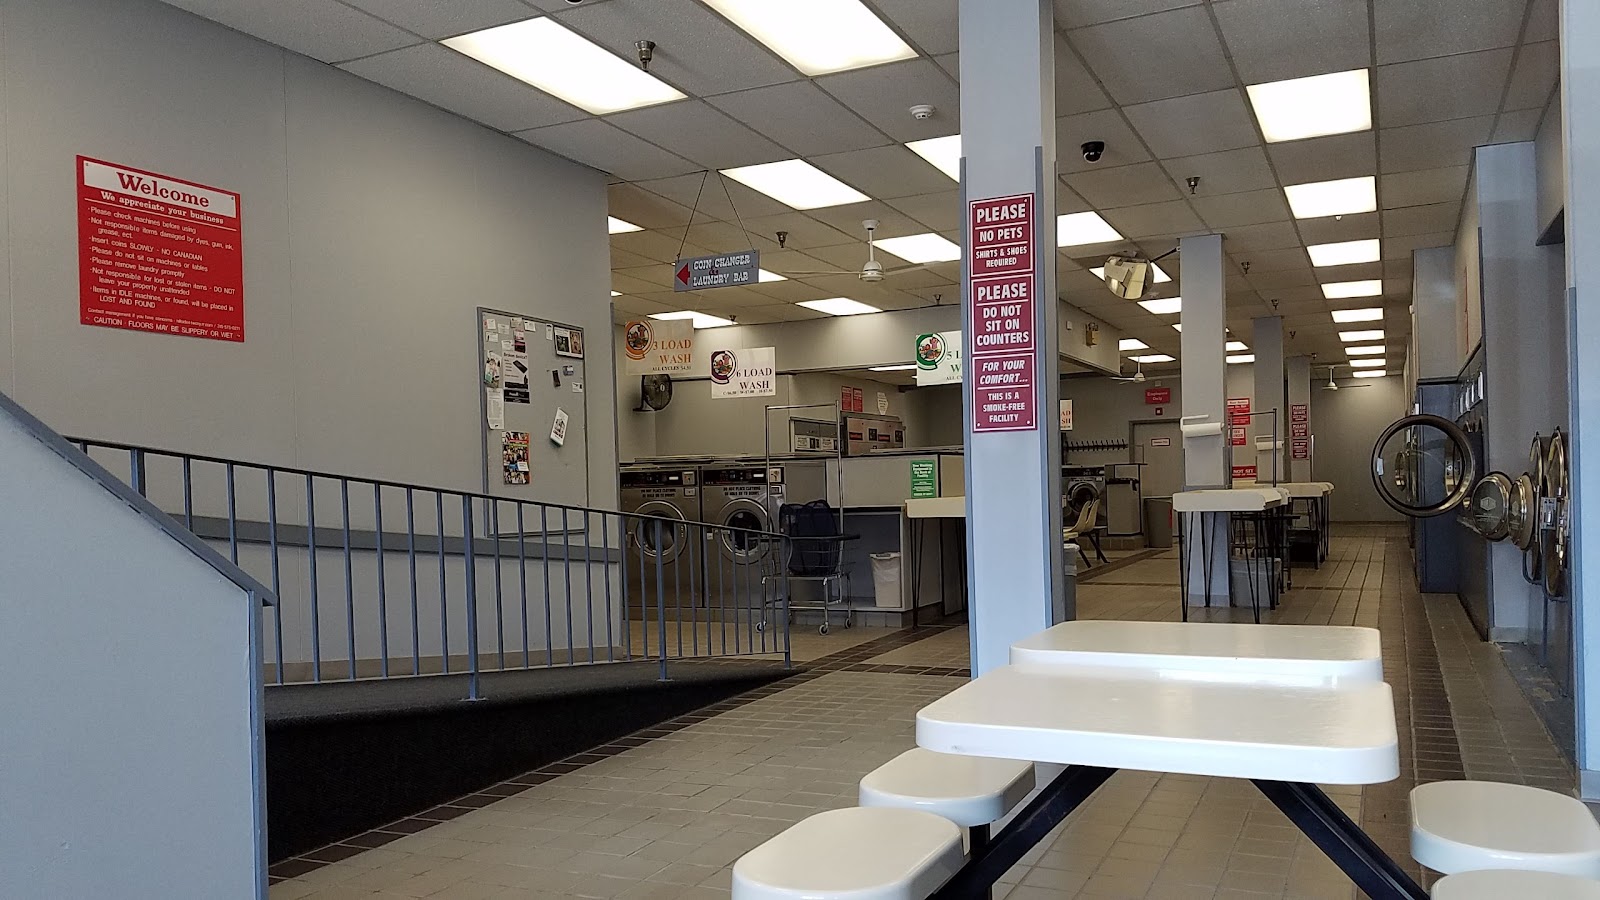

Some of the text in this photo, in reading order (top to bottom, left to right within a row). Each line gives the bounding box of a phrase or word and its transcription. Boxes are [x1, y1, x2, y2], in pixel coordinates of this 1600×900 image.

[116, 172, 209, 207] Welcome
[101, 191, 224, 224] We appreciate your business
[977, 203, 1026, 223] PLEASE
[91, 206, 111, 216] Please
[114, 212, 131, 220] check
[134, 216, 160, 226] machines
[163, 222, 180, 230] before
[105, 220, 139, 232] responsible
[160, 231, 185, 240] damaged
[980, 227, 1023, 242] NO PETS
[92, 236, 108, 244] Insert
[130, 243, 154, 252] SLOWLY
[173, 250, 202, 261] CANADIAN
[976, 249, 998, 259] SHIRTS
[1007, 246, 1027, 255] SHOES
[92, 246, 112, 255] Please
[156, 258, 181, 267] machines
[192, 264, 208, 272] tables
[693, 255, 751, 270] COIN CHANGER
[986, 257, 1017, 267] REQUIRED
[92, 256, 112, 265] Please
[138, 264, 159, 274] laundry
[161, 269, 185, 278] promptly
[106, 270, 141, 280] responsible
[693, 272, 748, 287] LAUNDRY BAR
[93, 286, 109, 294] Items
[99, 276, 114, 284] leave
[133, 283, 157, 292] property
[160, 286, 189, 295] unattended
[978, 283, 1026, 301] PLEASE
[135, 300, 155, 308] FOUND
[983, 305, 1021, 318] DO NOT
[94, 317, 122, 325] CAUTION
[129, 321, 154, 329] FLOORS
[182, 327, 208, 335] SLIPPERY
[986, 319, 1019, 332] SIT ON
[653, 339, 692, 350] 3 LOAD
[977, 331, 1029, 346] COUNTERS
[660, 354, 691, 364] WASH
[947, 351, 952, 360] 5
[744, 368, 772, 377] LOAD
[982, 360, 1025, 372] FOR YOUR
[740, 381, 769, 389] WASH
[980, 373, 1028, 384] COMFORT...
[983, 403, 1025, 412] SMOKE-FREE
[989, 414, 1019, 422] FACILITY
